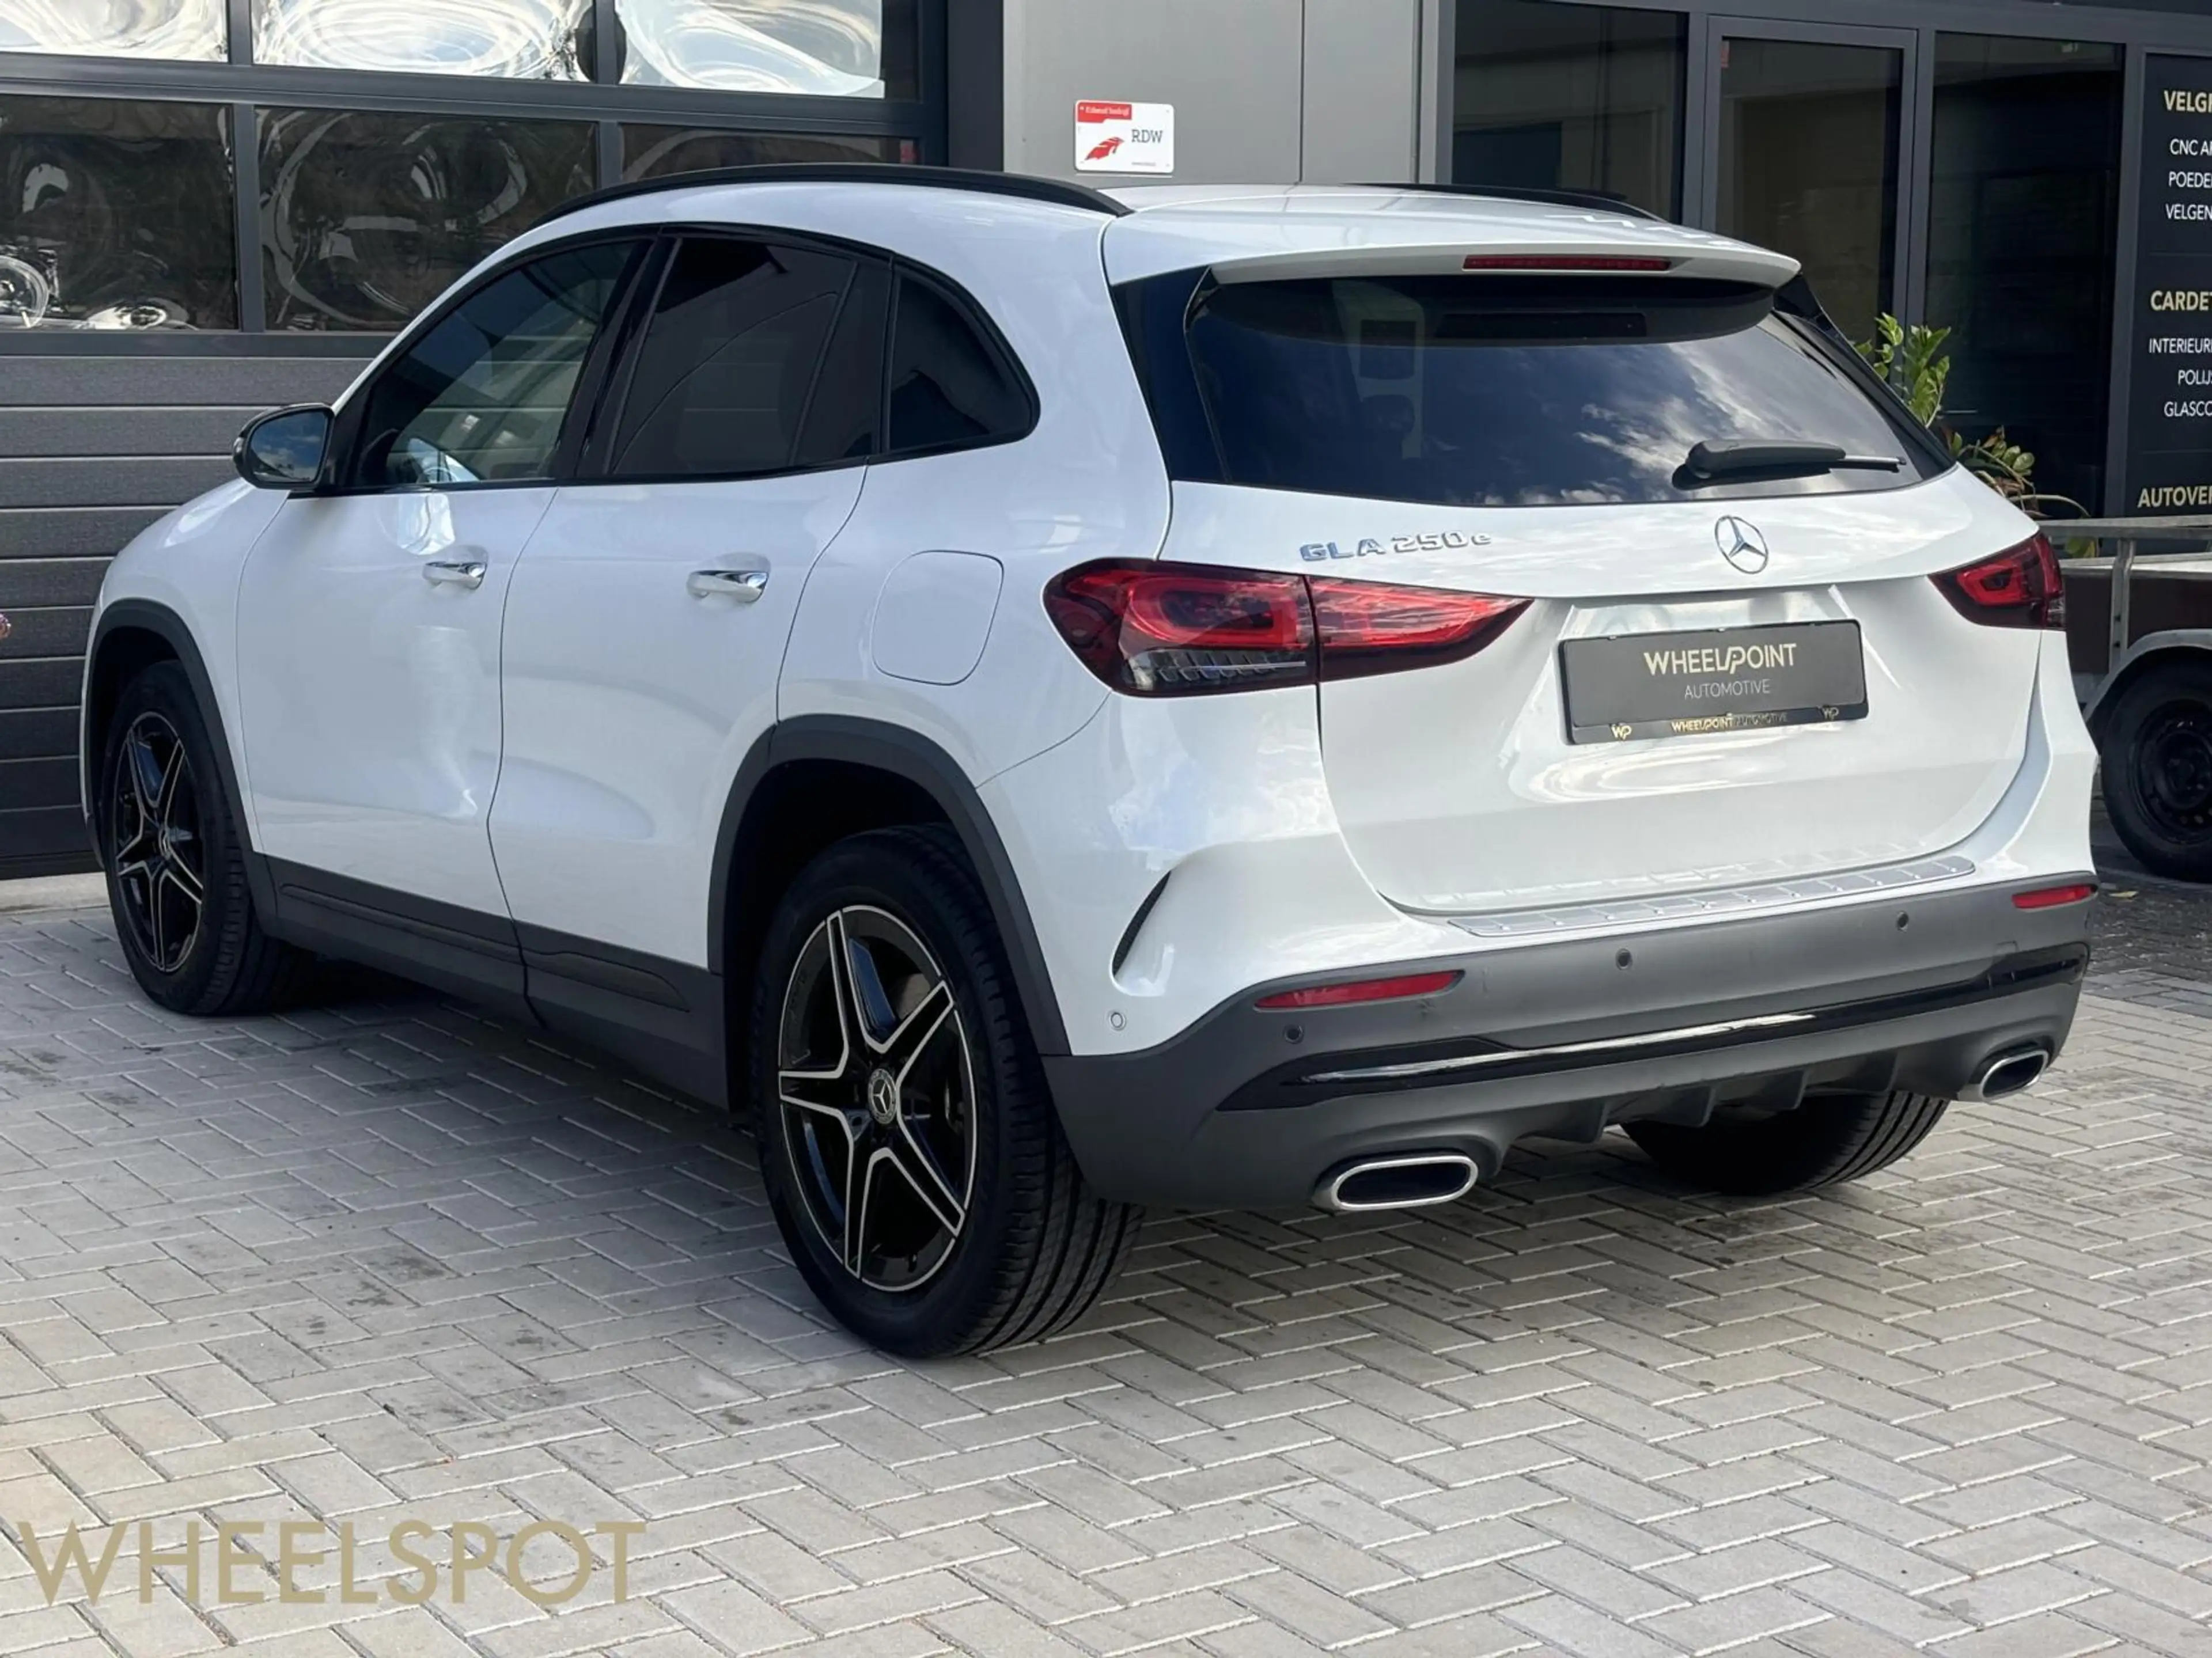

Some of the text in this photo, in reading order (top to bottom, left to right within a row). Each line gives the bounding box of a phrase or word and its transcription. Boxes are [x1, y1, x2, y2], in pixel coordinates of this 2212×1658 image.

[1131, 128, 1163, 144] RDW
[2169, 138, 2212, 157] CNC A
[2168, 170, 2212, 189] POEDE
[2148, 337, 2212, 354] INTERIEUR
[1299, 538, 1386, 562] GLA
[1643, 642, 1797, 676] WHEELPOINT
[1684, 679, 1770, 700] AUTOMOTIVE
